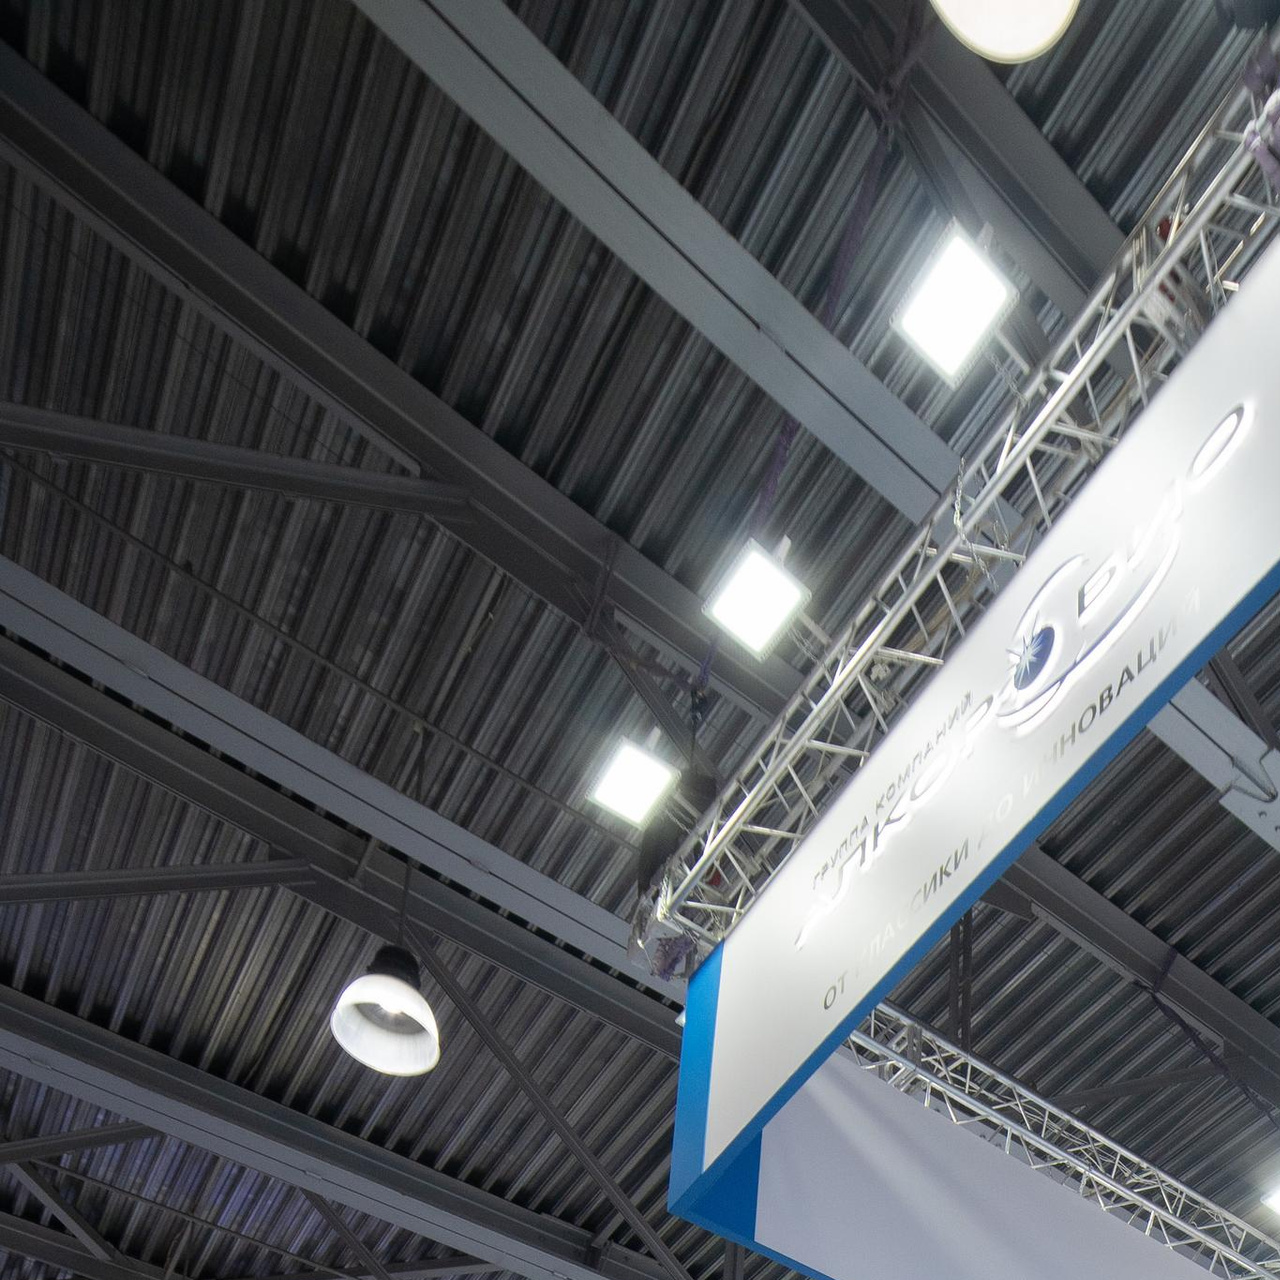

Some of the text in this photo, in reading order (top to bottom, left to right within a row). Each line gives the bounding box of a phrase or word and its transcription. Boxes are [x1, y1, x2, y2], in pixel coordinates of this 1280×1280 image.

[812, 689, 975, 890] ГРУППА КОМПАНИЙ
[823, 969, 848, 1011] ОТ
